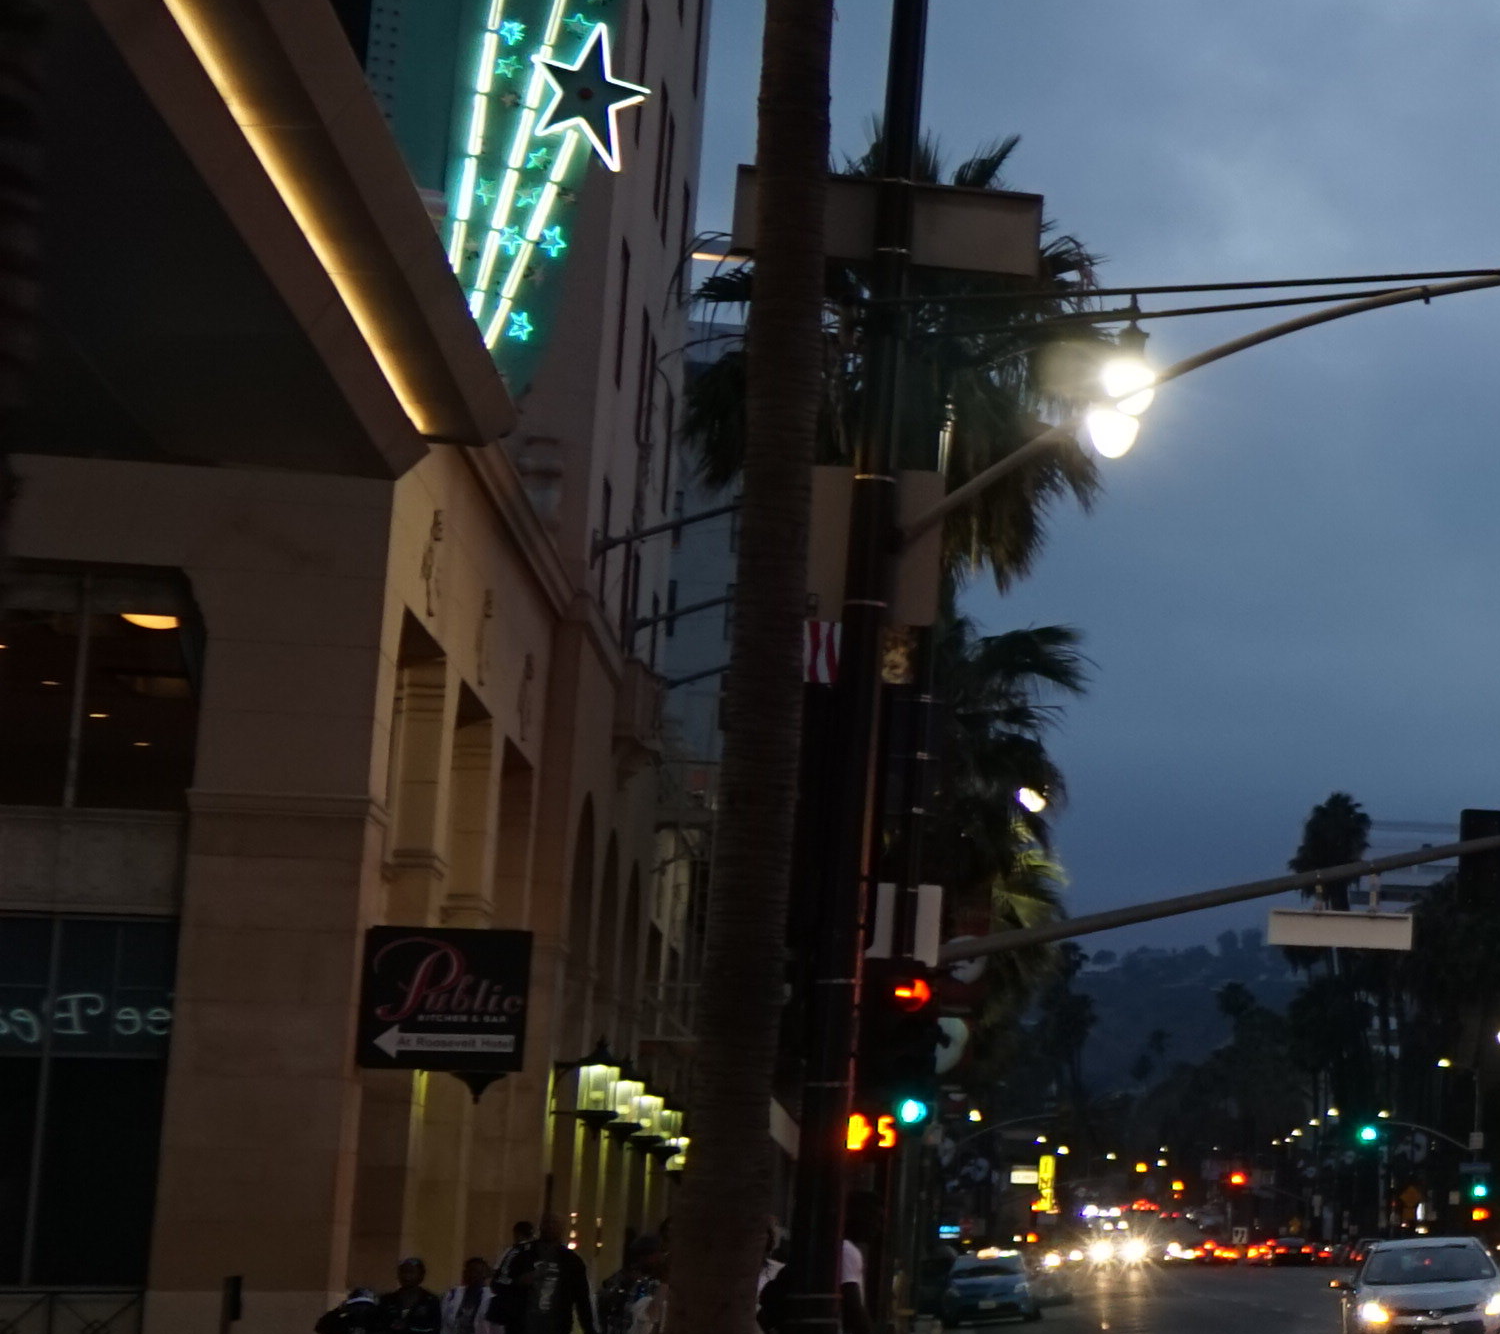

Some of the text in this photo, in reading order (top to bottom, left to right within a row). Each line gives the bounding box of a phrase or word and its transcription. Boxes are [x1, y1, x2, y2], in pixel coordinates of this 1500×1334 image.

[373, 936, 524, 1022] Public
[482, 1014, 507, 1023] BAR
[416, 1035, 477, 1047] Roosevelt
[481, 1036, 515, 1048] Hotel
[878, 1115, 897, 1148] 5
